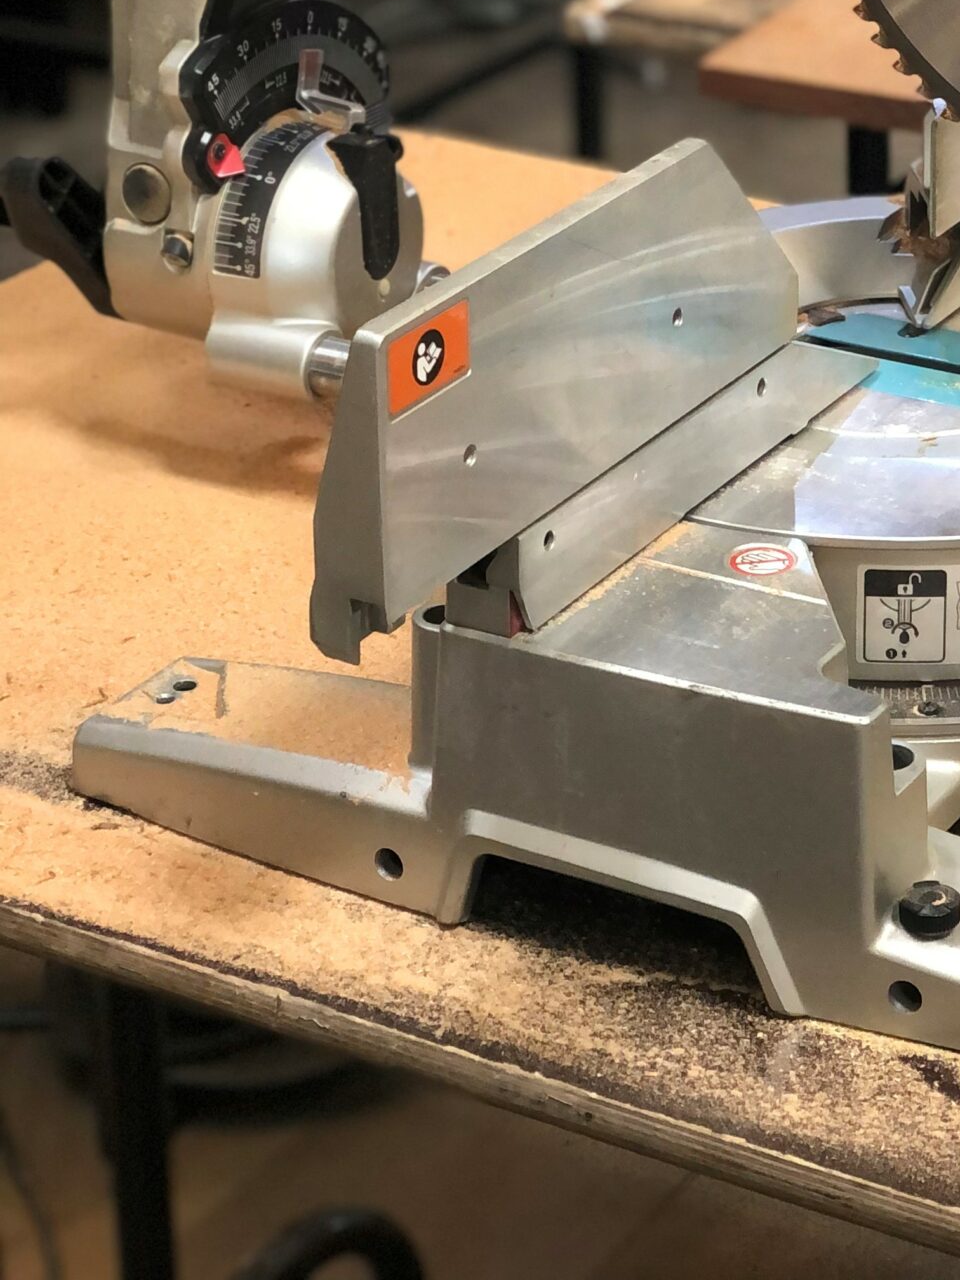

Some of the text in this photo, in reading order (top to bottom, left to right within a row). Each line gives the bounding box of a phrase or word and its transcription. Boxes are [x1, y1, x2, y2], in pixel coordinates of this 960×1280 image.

[271, 18, 282, 32] 15
[307, 10, 314, 24] 0
[236, 40, 250, 58] 30
[207, 73, 220, 93] 45
